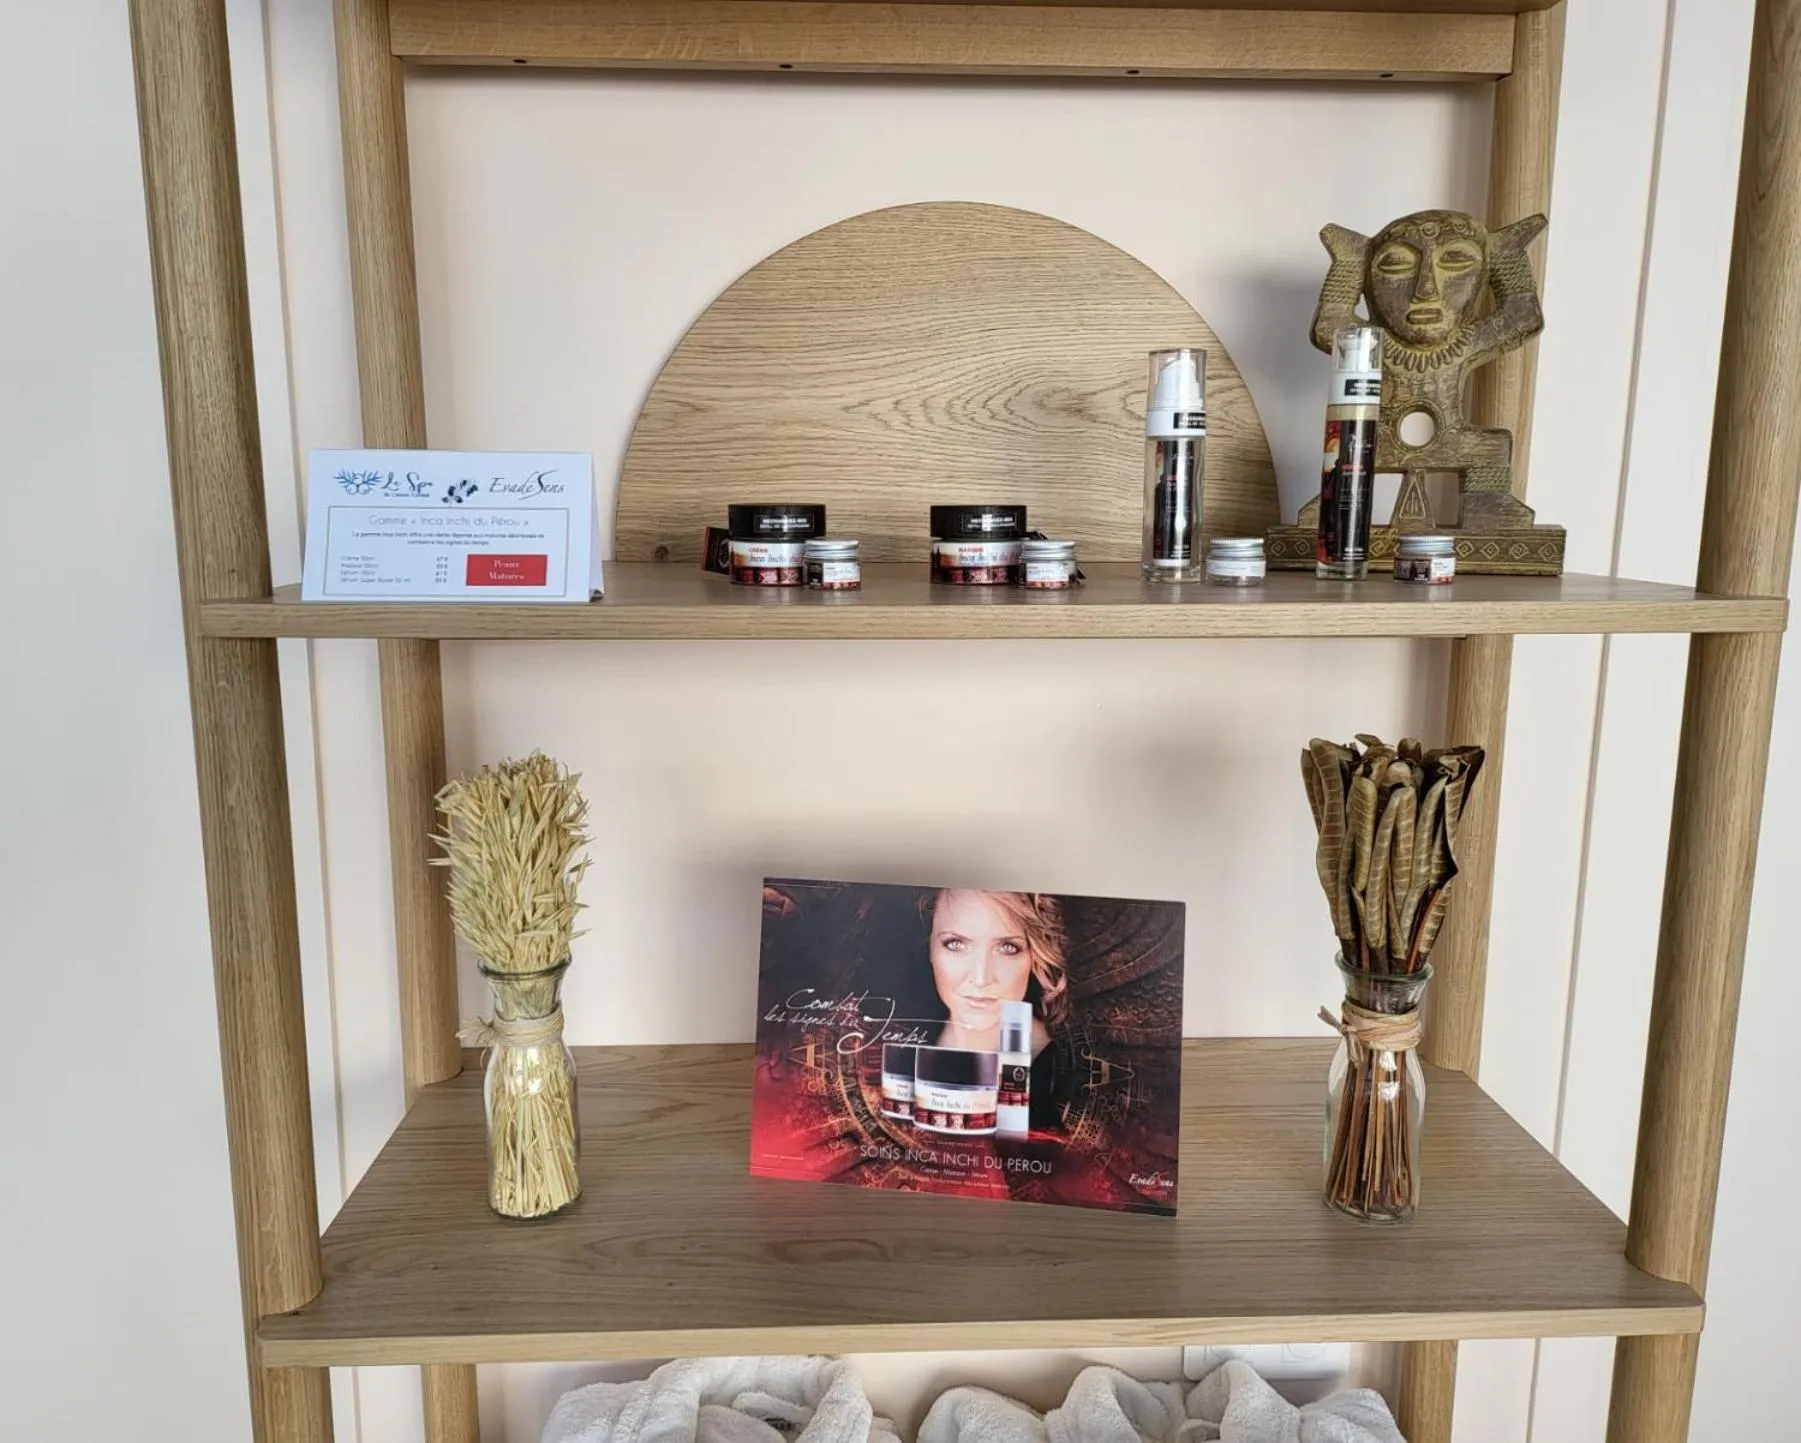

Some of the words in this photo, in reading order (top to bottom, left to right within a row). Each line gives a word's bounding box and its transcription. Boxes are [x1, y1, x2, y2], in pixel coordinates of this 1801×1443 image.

[859, 1143, 900, 1162] SOINS
[905, 1149, 938, 1164] INCA
[942, 1152, 979, 1168] INCHI
[984, 1156, 1002, 1170] DU
[1007, 1157, 1052, 1175] PEROU
